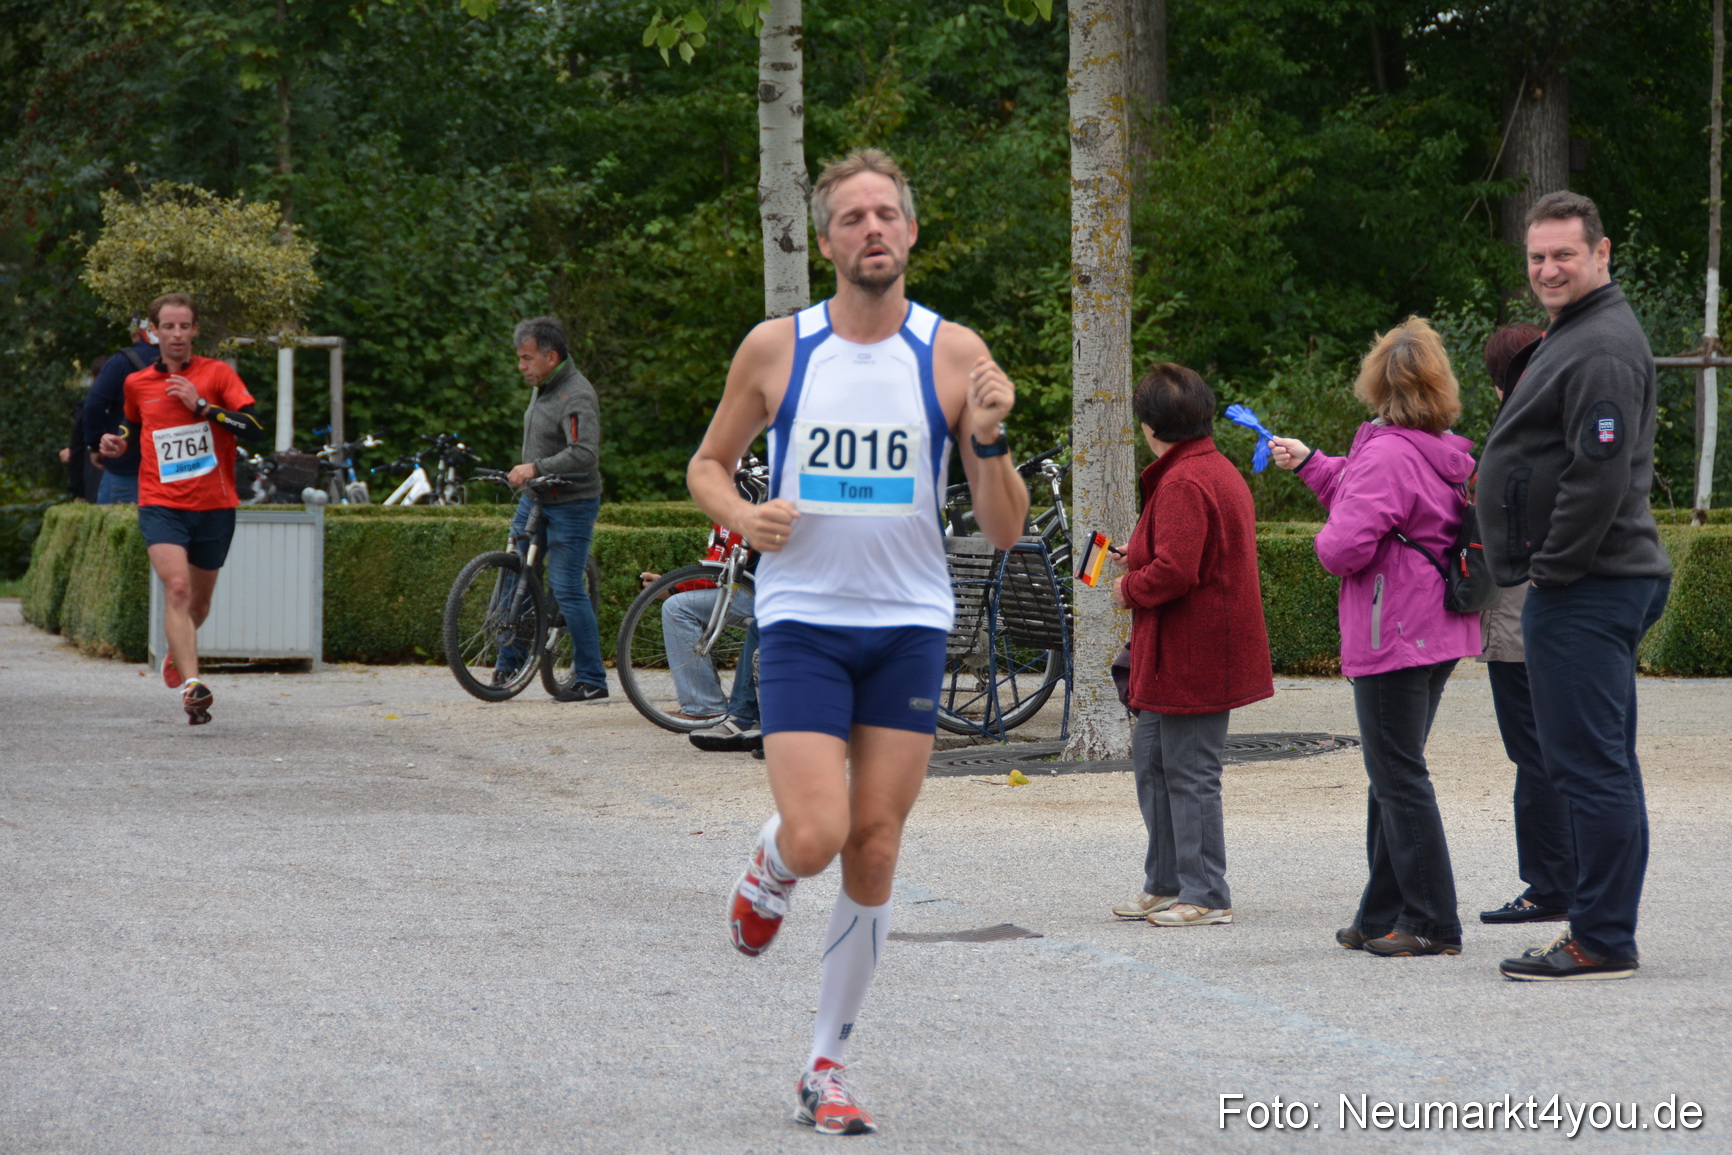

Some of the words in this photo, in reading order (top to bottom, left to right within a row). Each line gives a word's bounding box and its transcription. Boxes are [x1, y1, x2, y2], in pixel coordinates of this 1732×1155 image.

[161, 435, 209, 461] 2764
[808, 427, 908, 471] 2016
[175, 461, 200, 473] Jürgen
[838, 481, 873, 499] Tom
